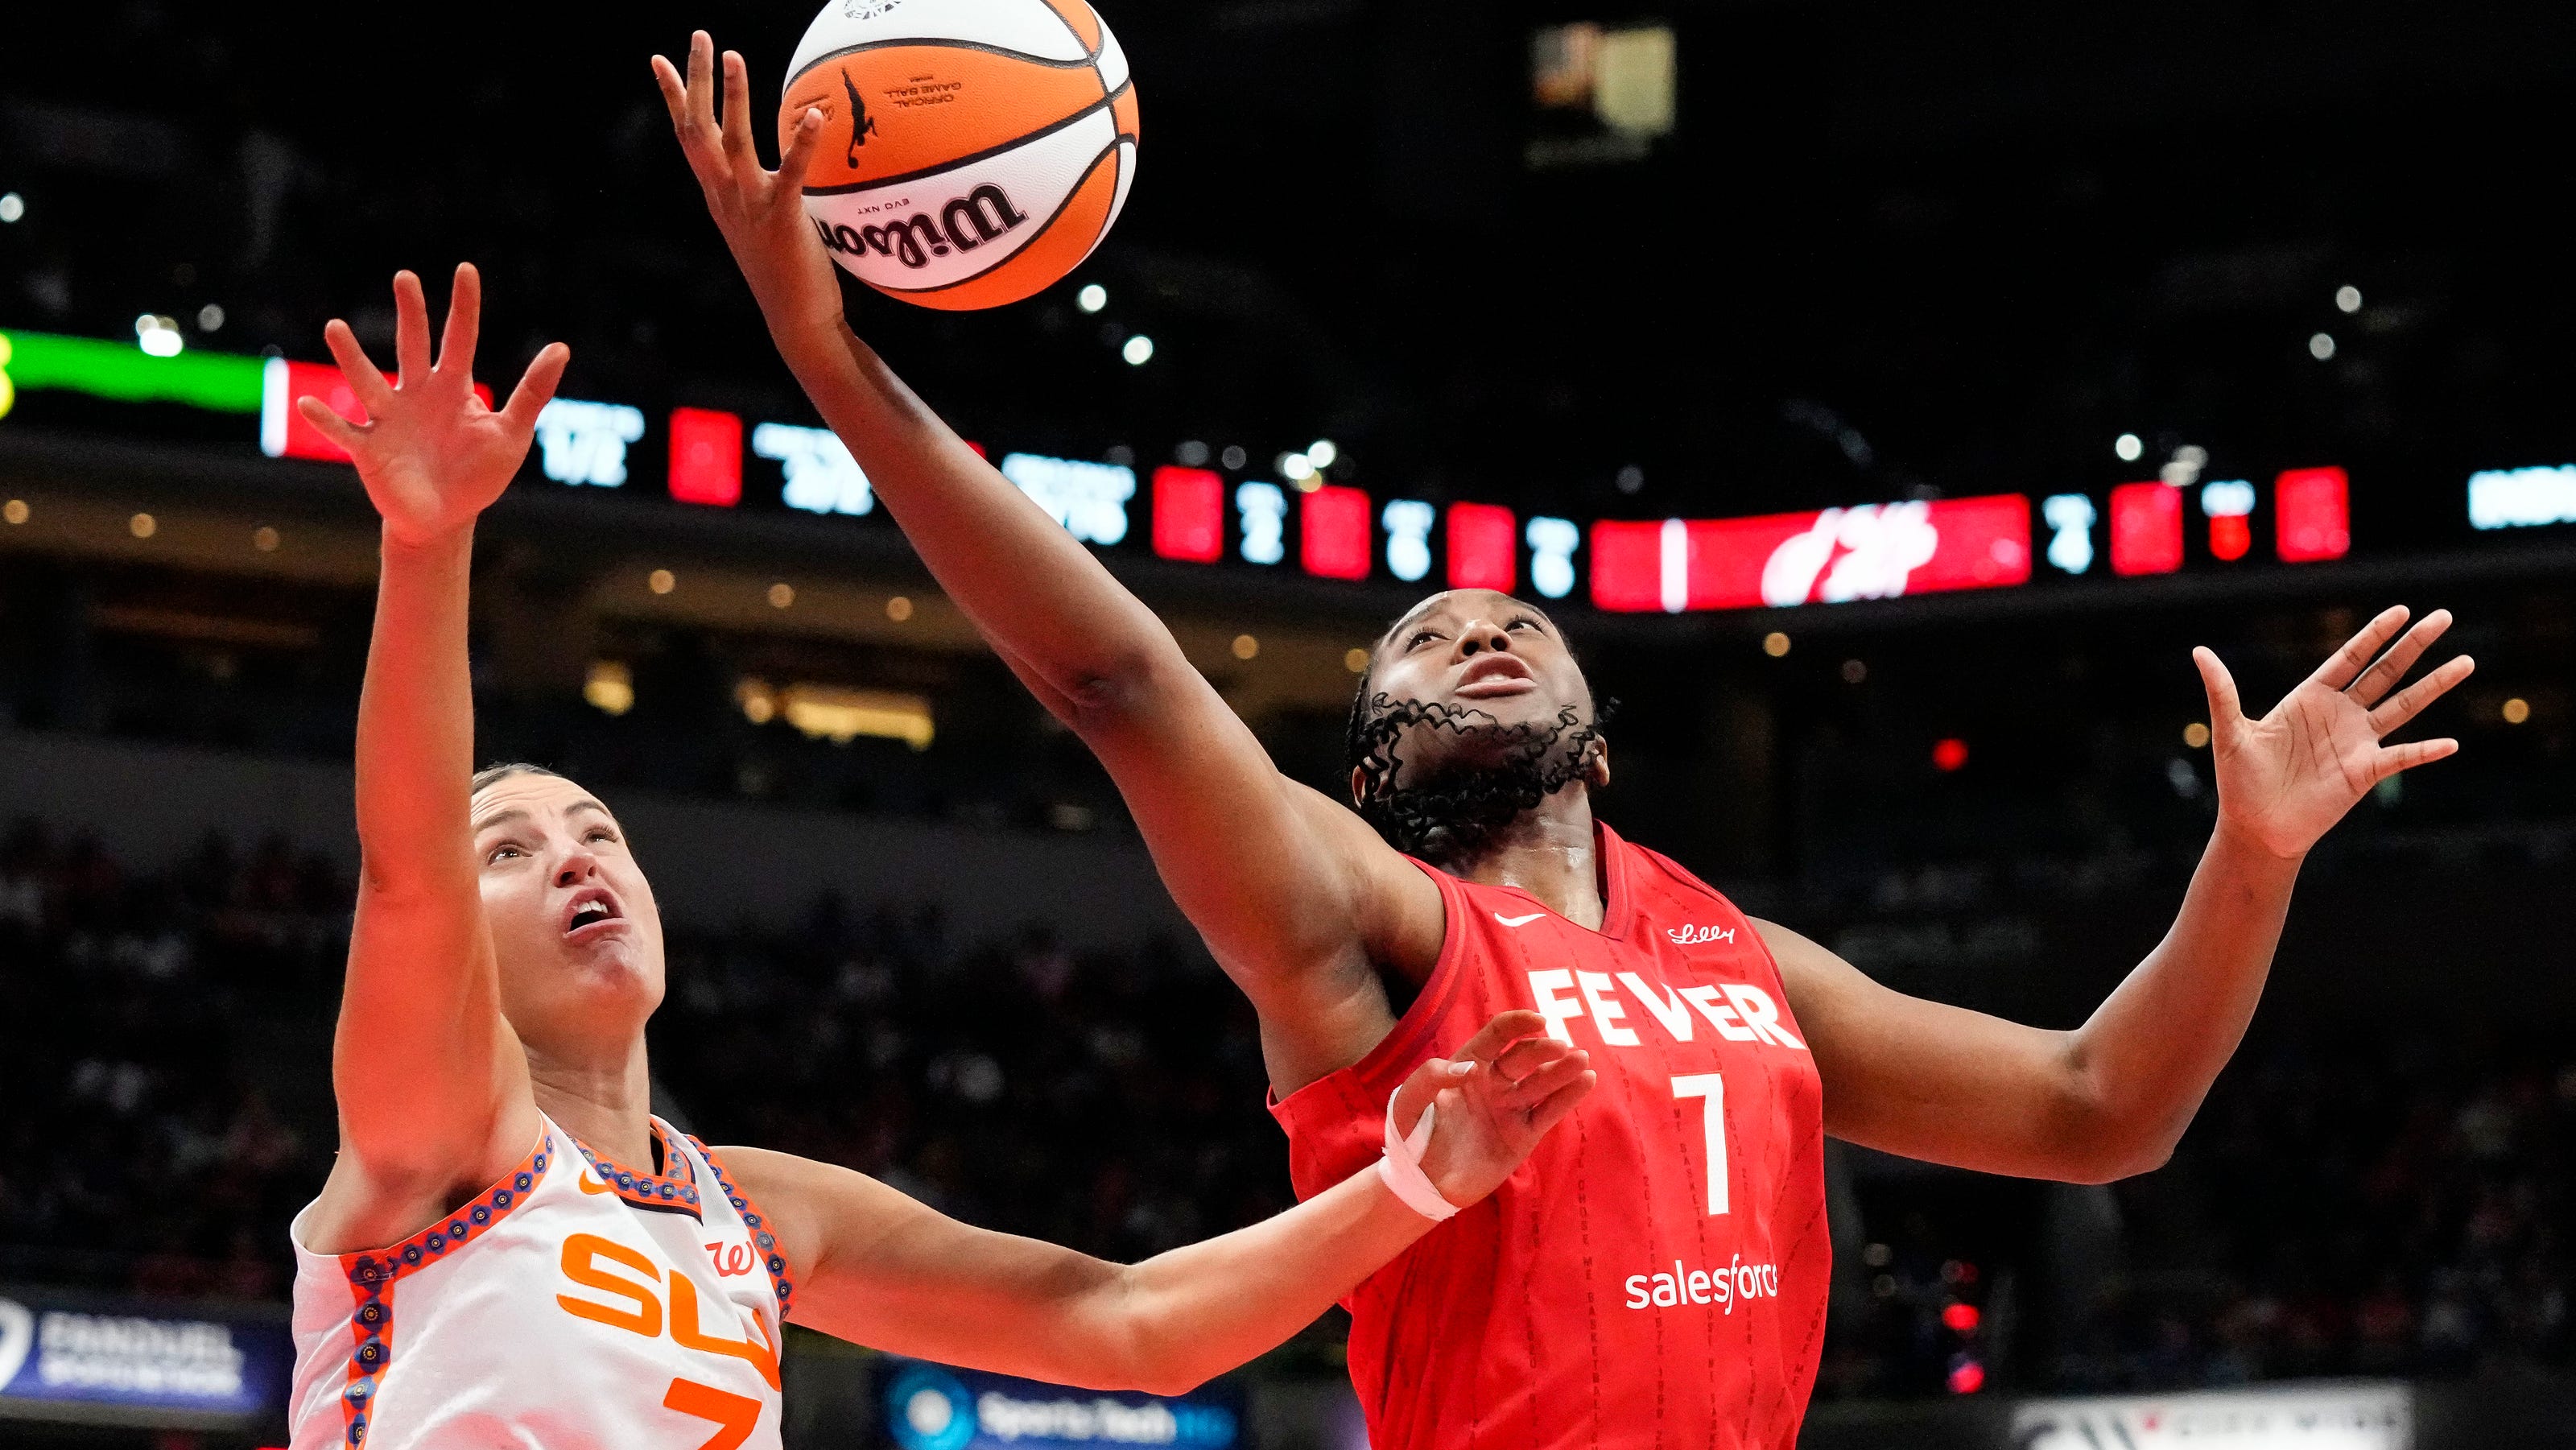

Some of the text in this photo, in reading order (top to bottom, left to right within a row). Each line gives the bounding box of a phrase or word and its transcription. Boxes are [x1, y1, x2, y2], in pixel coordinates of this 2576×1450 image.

[884, 81, 962, 98] GAME BALL
[894, 93, 954, 108] OFFICIAL
[857, 205, 880, 214] NXT
[811, 183, 1030, 269] Wilson
[1667, 923, 1736, 944] Lilly
[1528, 969, 1806, 1049] FEVER
[1670, 1072, 1730, 1216] 7
